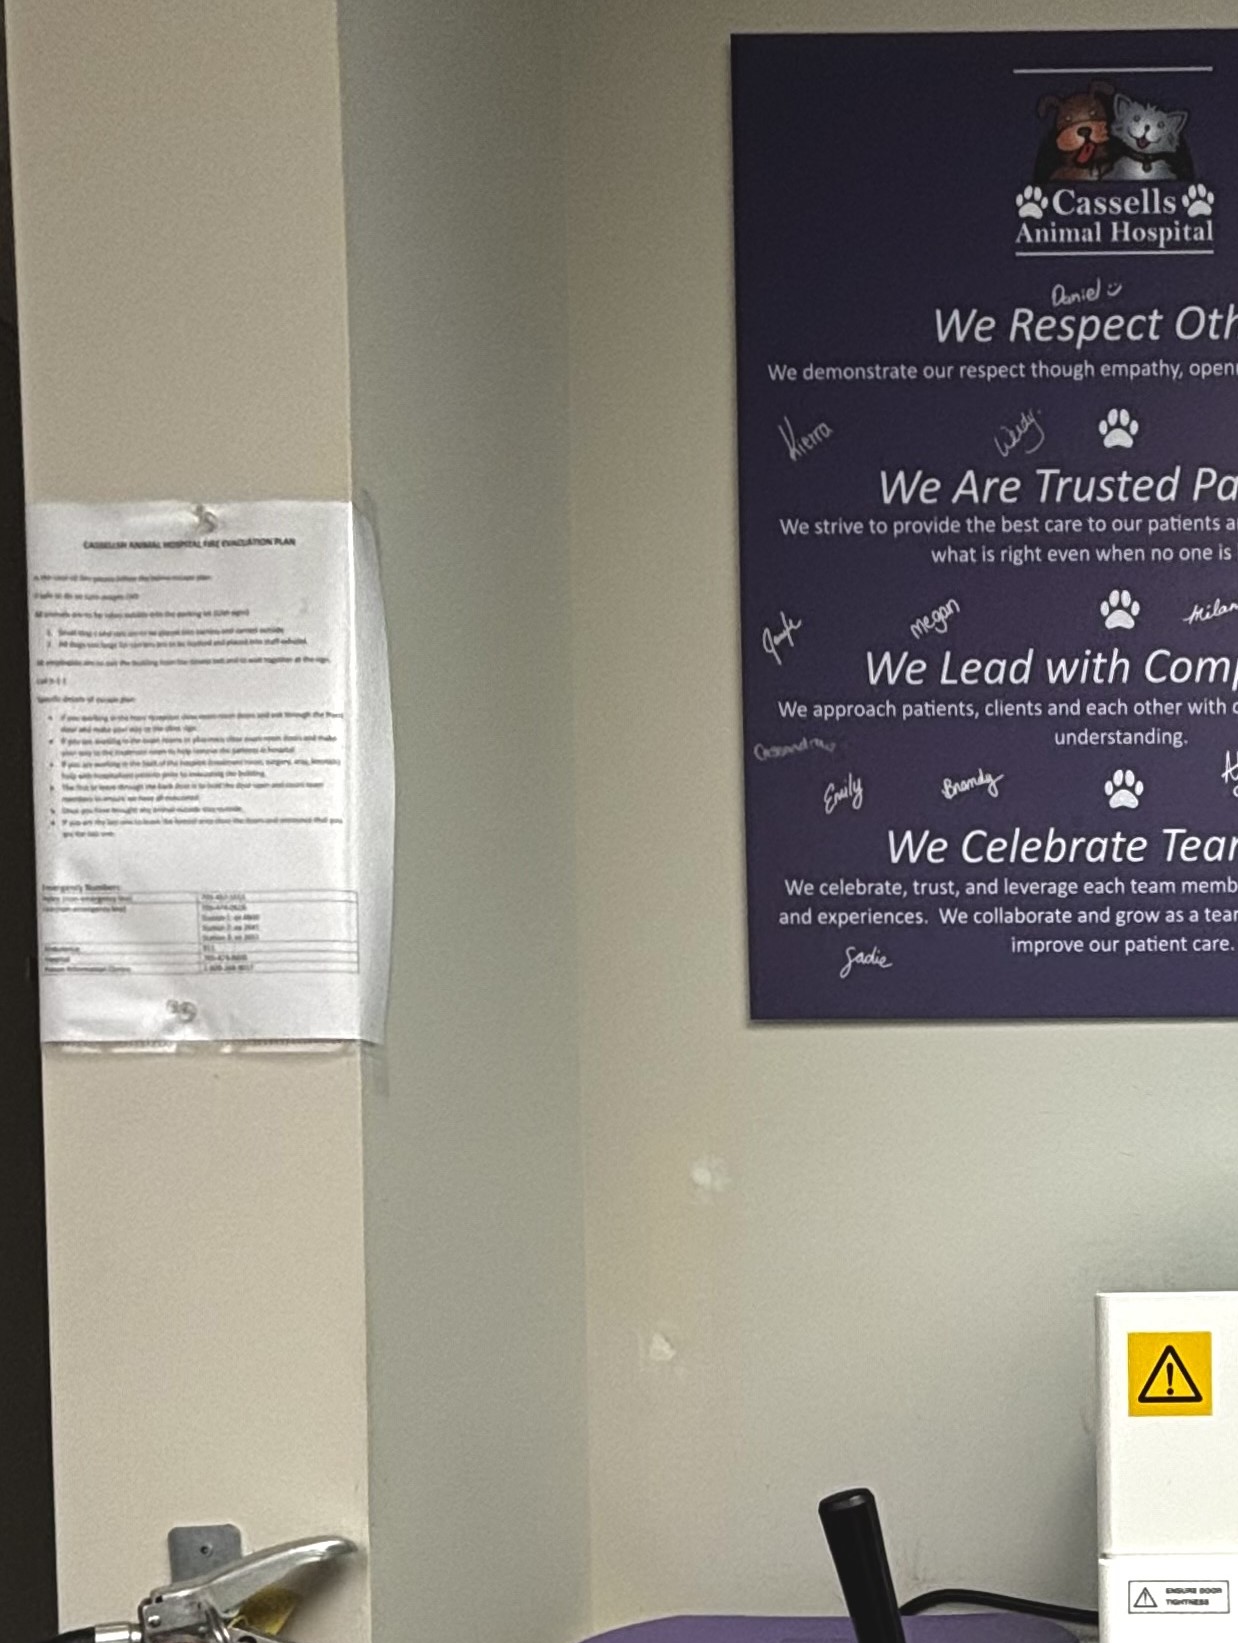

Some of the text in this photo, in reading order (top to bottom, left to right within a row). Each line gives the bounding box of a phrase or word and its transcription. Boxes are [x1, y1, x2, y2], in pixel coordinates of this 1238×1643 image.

[1052, 188, 1177, 216] Cassells
[1015, 219, 1214, 249] Animal Hospital
[1051, 277, 1101, 307] Daniel
[935, 308, 996, 343] We
[1009, 304, 1164, 350] Respect
[767, 363, 798, 381] We
[802, 362, 918, 381] demonstrate
[922, 365, 955, 380] our
[959, 362, 1026, 382] respect
[1030, 359, 1095, 382] though
[1100, 358, 1184, 381] empathy,
[880, 469, 942, 505] We
[951, 469, 1022, 504] Are
[1035, 465, 1181, 504] Trusted
[779, 518, 810, 536] We
[814, 517, 864, 535] strive
[868, 518, 888, 535] to
[893, 515, 961, 538] provide
[965, 515, 996, 534] the
[1001, 515, 1040, 533] best
[1044, 518, 1083, 533] care
[1086, 516, 1107, 533] to
[1111, 518, 1143, 532] our
[1147, 514, 1221, 536] patients
[930, 545, 977, 564] what
[981, 545, 996, 563] is
[1000, 544, 1043, 567] right
[1047, 548, 1091, 563] even
[1095, 543, 1146, 562] when
[1150, 547, 1174, 562] no
[1178, 547, 1214, 562] one
[1218, 543, 1232, 561] is
[866, 650, 927, 686] We
[940, 647, 1034, 685] Lead
[1046, 647, 1130, 685] with
[777, 700, 808, 718] We
[812, 699, 897, 722] approach
[902, 699, 980, 721] patients,
[984, 698, 1043, 717] clients
[1047, 698, 1081, 716] and
[1085, 697, 1128, 716] each
[1133, 697, 1183, 716] other
[1187, 696, 1227, 716] with
[1054, 727, 1189, 749] understanding.
[888, 829, 949, 864] We
[961, 826, 1148, 864] Celebrate
[784, 879, 815, 896] We
[818, 877, 908, 898] celebrate,
[912, 879, 960, 898] trust,
[964, 877, 999, 896] and
[1003, 877, 1079, 899] leverage
[1083, 876, 1126, 895] each
[1129, 878, 1176, 895] team
[778, 907, 812, 925] and
[817, 907, 929, 929] experiences.
[938, 907, 969, 925] We
[973, 906, 1073, 925] collaborate
[1077, 905, 1111, 924] and
[1114, 910, 1161, 928] grow
[1164, 909, 1185, 923] as
[1188, 909, 1199, 923] a
[1011, 935, 1235, 957] improve our patient care.
[839, 945, 893, 979] Sadie
